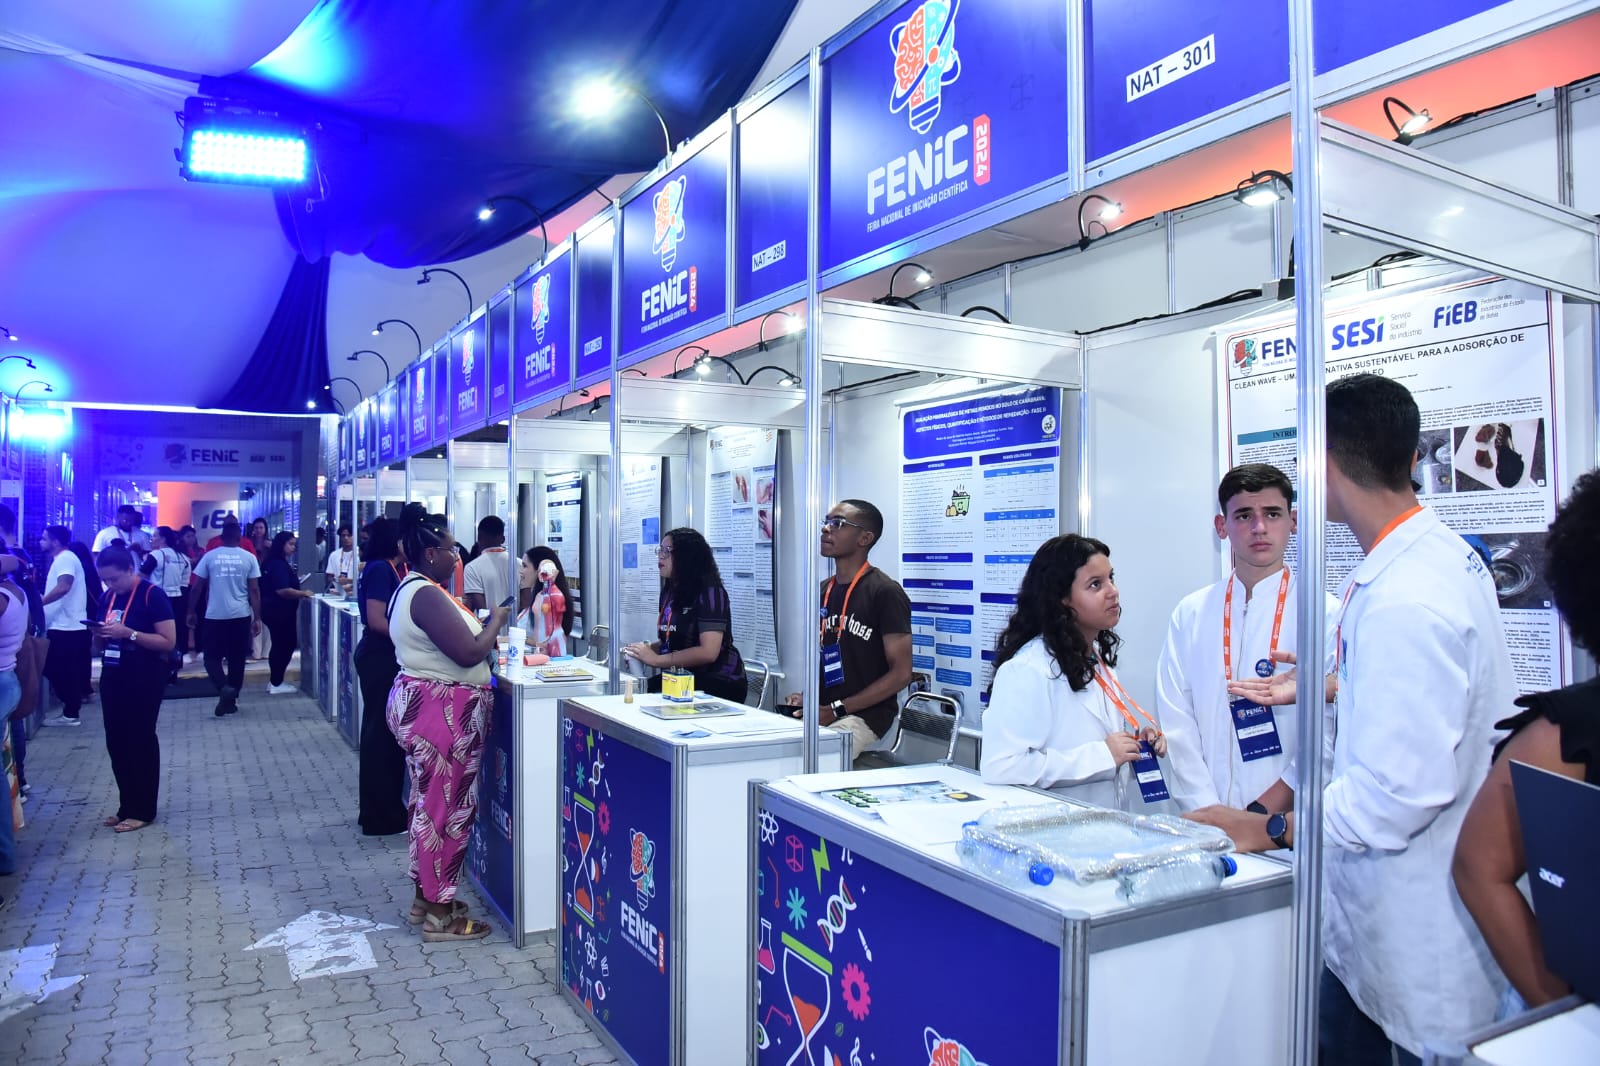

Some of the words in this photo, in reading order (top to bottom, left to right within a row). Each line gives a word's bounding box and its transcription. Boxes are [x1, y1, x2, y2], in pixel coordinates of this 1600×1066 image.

[1130, 64, 1163, 97] NAT
[1183, 39, 1211, 71] 301
[975, 123, 988, 178] 2024
[753, 252, 766, 270] NAT
[1234, 380, 1256, 390] CLEAN
[1257, 376, 1277, 386] WAVE
[1284, 372, 1297, 382] UM
[1325, 361, 1353, 375] NATIVA
[1354, 351, 1415, 369] SUSTENTÁVEL
[1417, 347, 1442, 358] PARA
[1444, 346, 1451, 354] A
[1452, 335, 1508, 353] ADSORÇÃO
[1511, 333, 1525, 343] DE
[1262, 337, 1297, 360] FEN
[1539, 867, 1565, 888] acer
